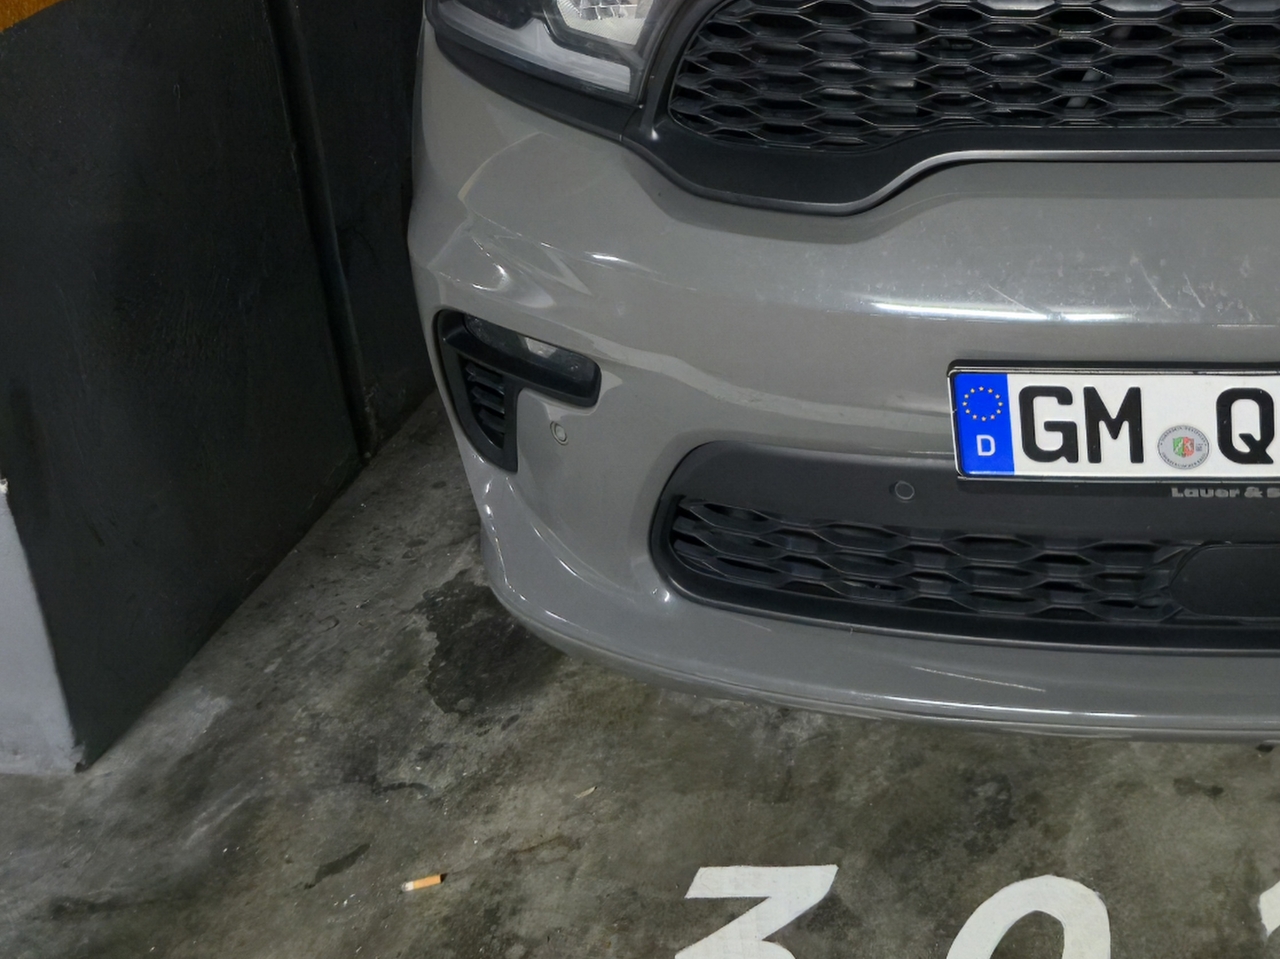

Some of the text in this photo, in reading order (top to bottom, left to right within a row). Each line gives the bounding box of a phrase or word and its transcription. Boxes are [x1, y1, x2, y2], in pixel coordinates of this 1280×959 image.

[1018, 385, 1145, 464] GM
[976, 435, 995, 456] D
[1171, 487, 1240, 498] Lauer
[1244, 486, 1263, 499] &
